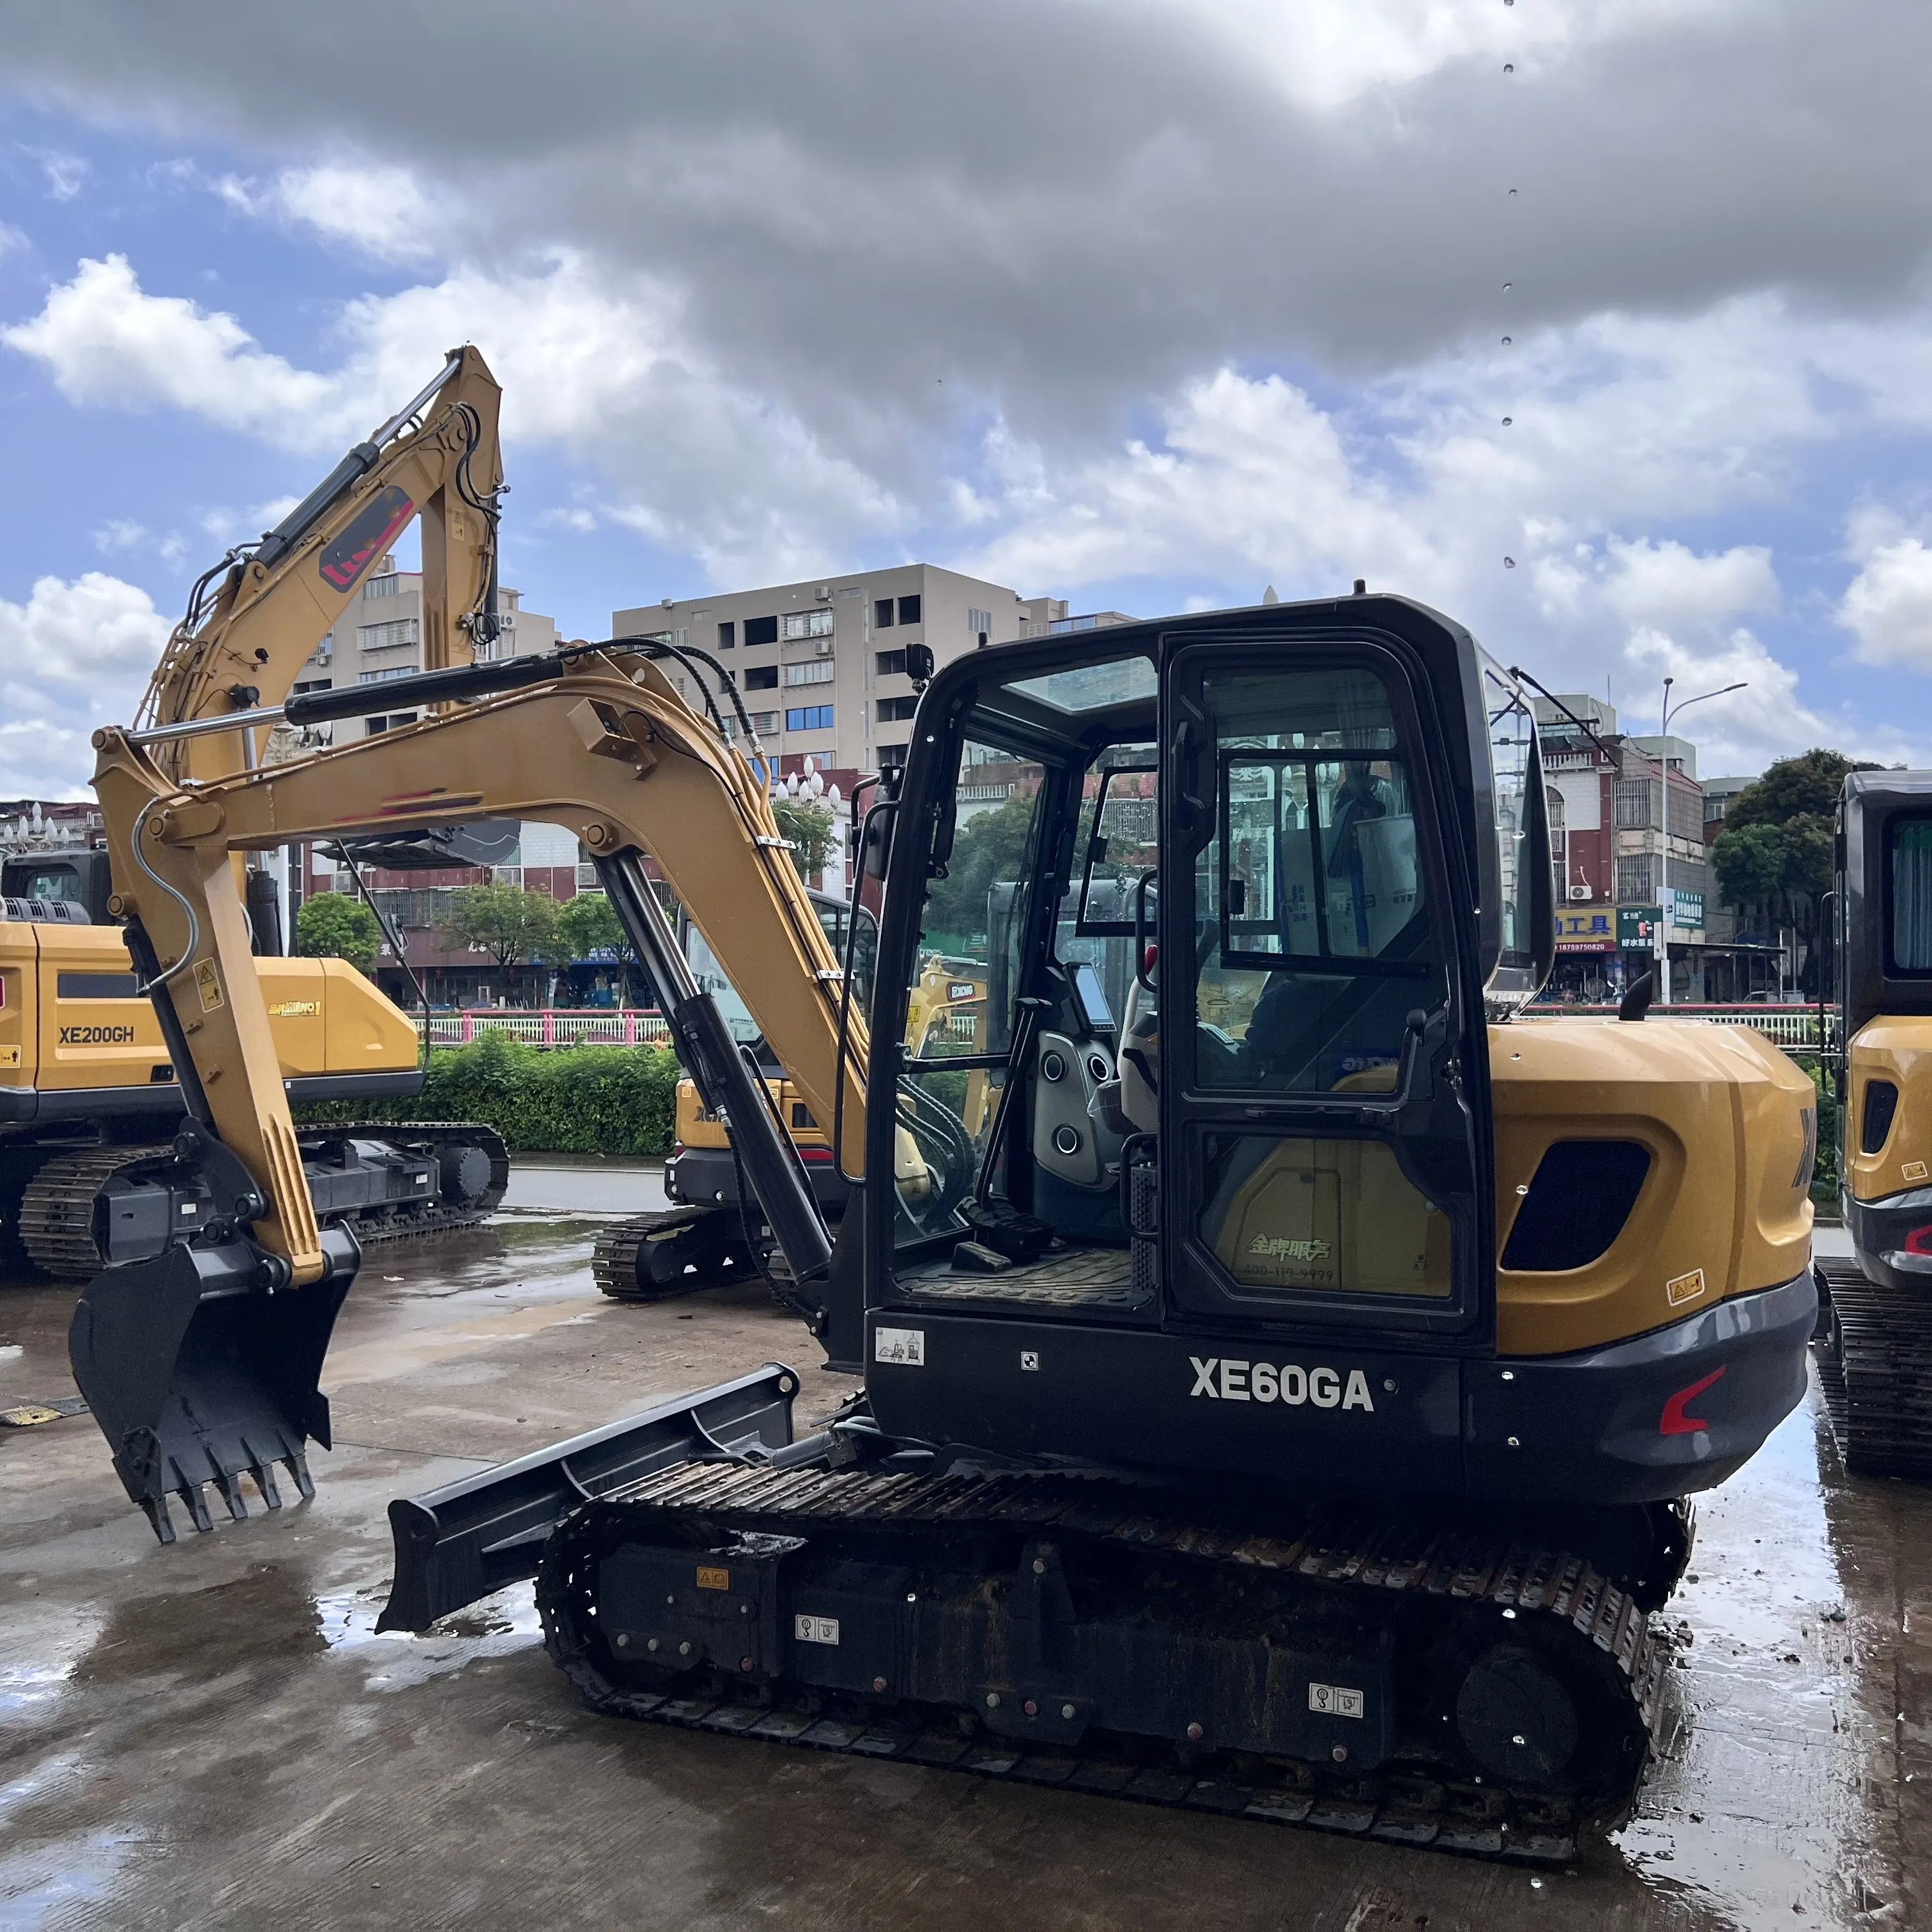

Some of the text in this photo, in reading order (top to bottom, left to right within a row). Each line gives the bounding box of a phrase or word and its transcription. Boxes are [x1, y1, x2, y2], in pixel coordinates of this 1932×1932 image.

[1554, 916, 1611, 935] 工具
[59, 1026, 134, 1044] XE200GH
[1248, 1232, 1331, 1262] 金牌服务
[1189, 1356, 1374, 1412] XE60GA
